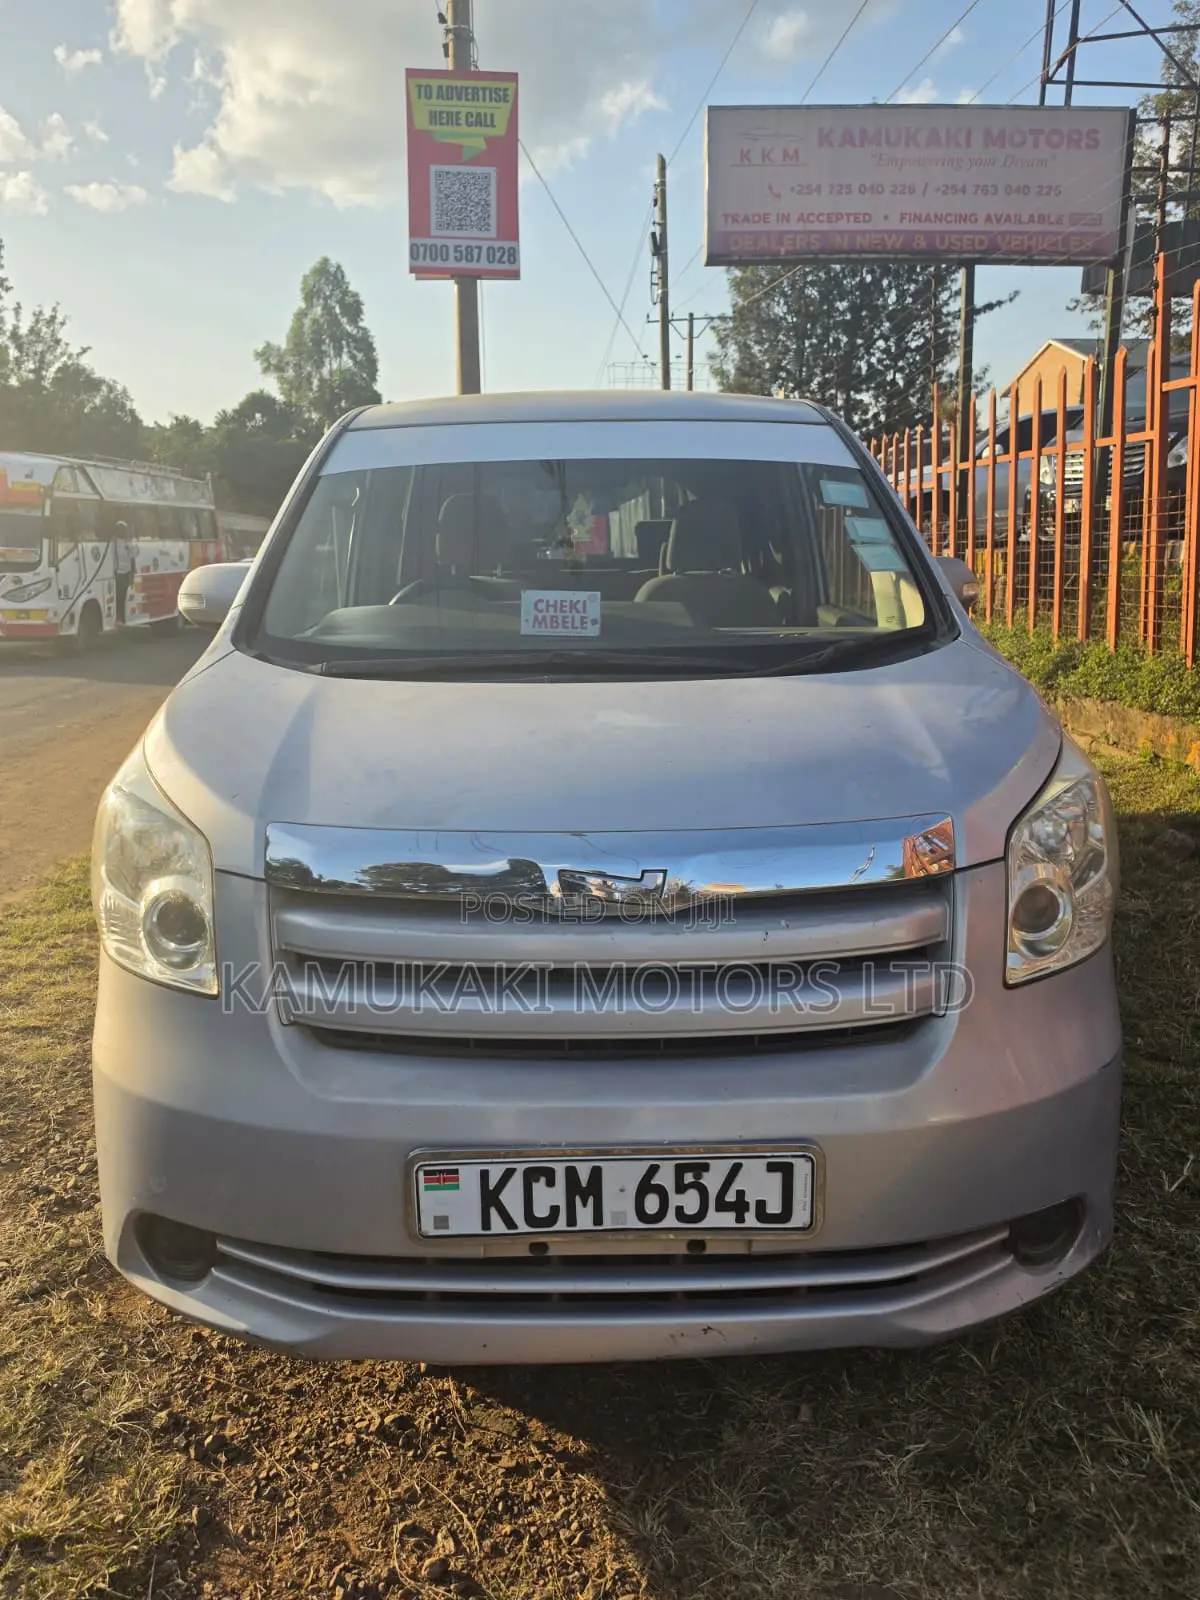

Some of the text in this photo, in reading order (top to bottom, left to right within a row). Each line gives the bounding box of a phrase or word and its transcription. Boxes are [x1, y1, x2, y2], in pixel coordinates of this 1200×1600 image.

[415, 84, 510, 103] TO ADVERTISE
[428, 110, 496, 128] HERE CALL
[818, 126, 1101, 150] KAMUKAKI MOTORS
[789, 183, 822, 196] +254
[934, 184, 967, 196] +254
[722, 213, 772, 225] TRADE
[776, 213, 791, 225] IN
[796, 213, 872, 225] ACCEPTED
[900, 213, 978, 225] FINANCING
[984, 213, 1065, 226] AVAILABLE
[729, 234, 821, 250] DEALERS
[830, 234, 848, 250] IN
[856, 233, 903, 250] NEW
[913, 234, 926, 249] &
[936, 234, 988, 250] USED
[410, 243, 517, 265] 0700 587 028
[533, 598, 587, 614] CHEKI
[532, 614, 588, 630] MBELE
[479, 1165, 604, 1232] KCM
[634, 1161, 795, 1225] 654J
